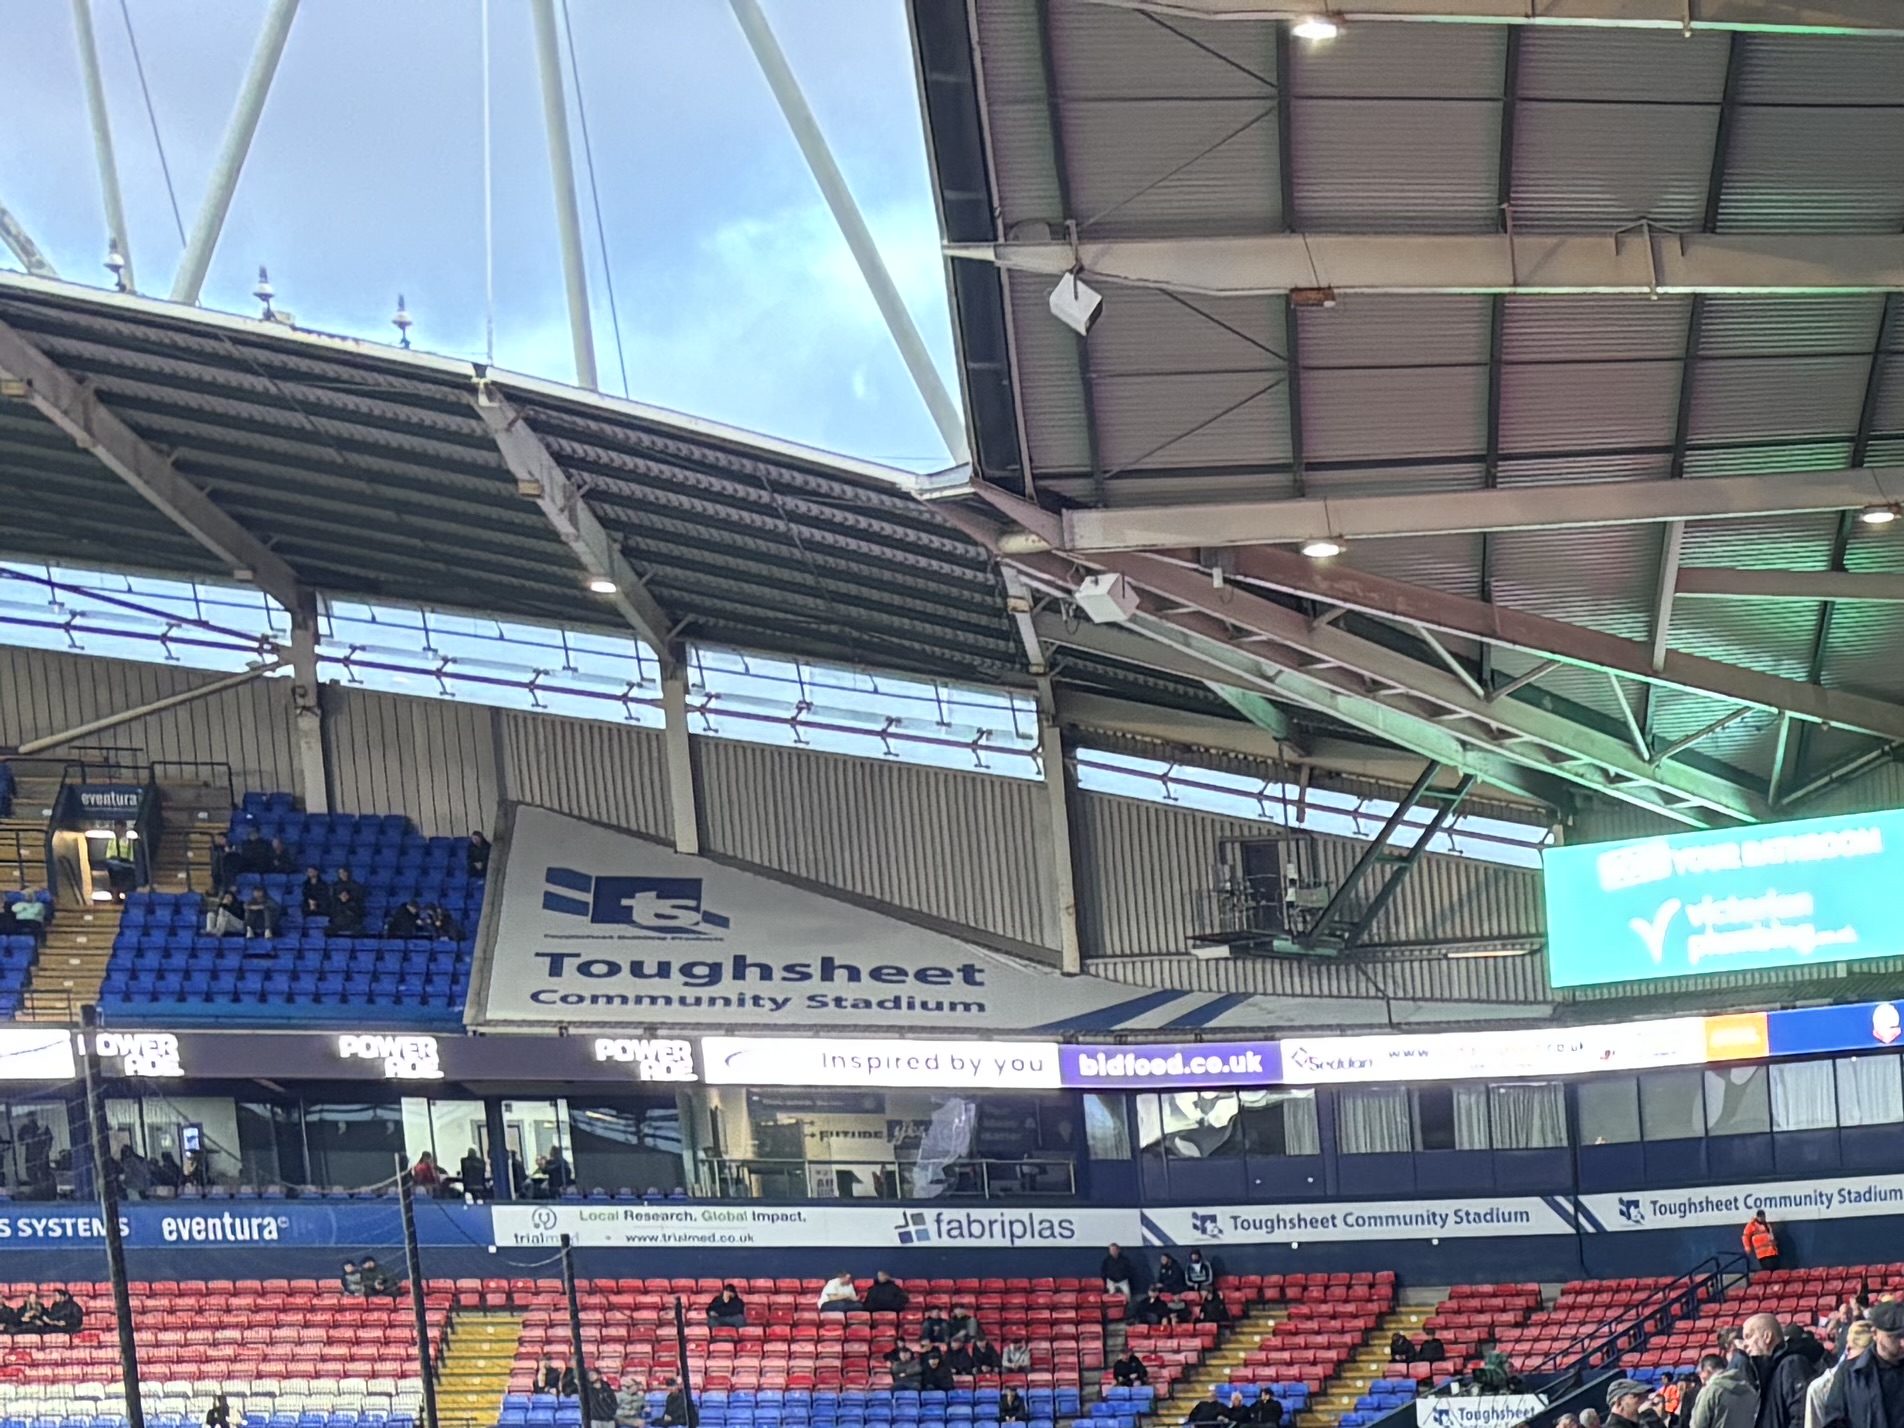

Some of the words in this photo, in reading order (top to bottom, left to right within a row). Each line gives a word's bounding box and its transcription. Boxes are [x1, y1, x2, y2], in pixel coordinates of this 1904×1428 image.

[534, 951, 986, 987] Toughsheet
[529, 988, 793, 1012] Community
[805, 992, 986, 1014] Stadium
[339, 1034, 439, 1059] POWER
[595, 1038, 693, 1062] POWER
[822, 1051, 940, 1075] Inspired
[951, 1052, 982, 1077] by
[993, 1056, 1045, 1078] you
[1078, 1050, 1264, 1077] bidfood.co.uk
[1650, 1196, 1740, 1221] Toughsheet
[1743, 1191, 1834, 1215] Community
[1837, 1183, 1904, 1206] Stadium
[162, 1211, 280, 1242] eventura
[579, 1210, 619, 1222] Local
[701, 1209, 748, 1223] Global
[933, 1210, 1077, 1247] fabriplas
[1229, 1213, 1339, 1236] Toughsheet
[1342, 1208, 1449, 1233] Community
[1453, 1206, 1531, 1226] Stadium
[514, 1231, 579, 1245] trialmd
[1457, 1405, 1536, 1425] Toughsheet
